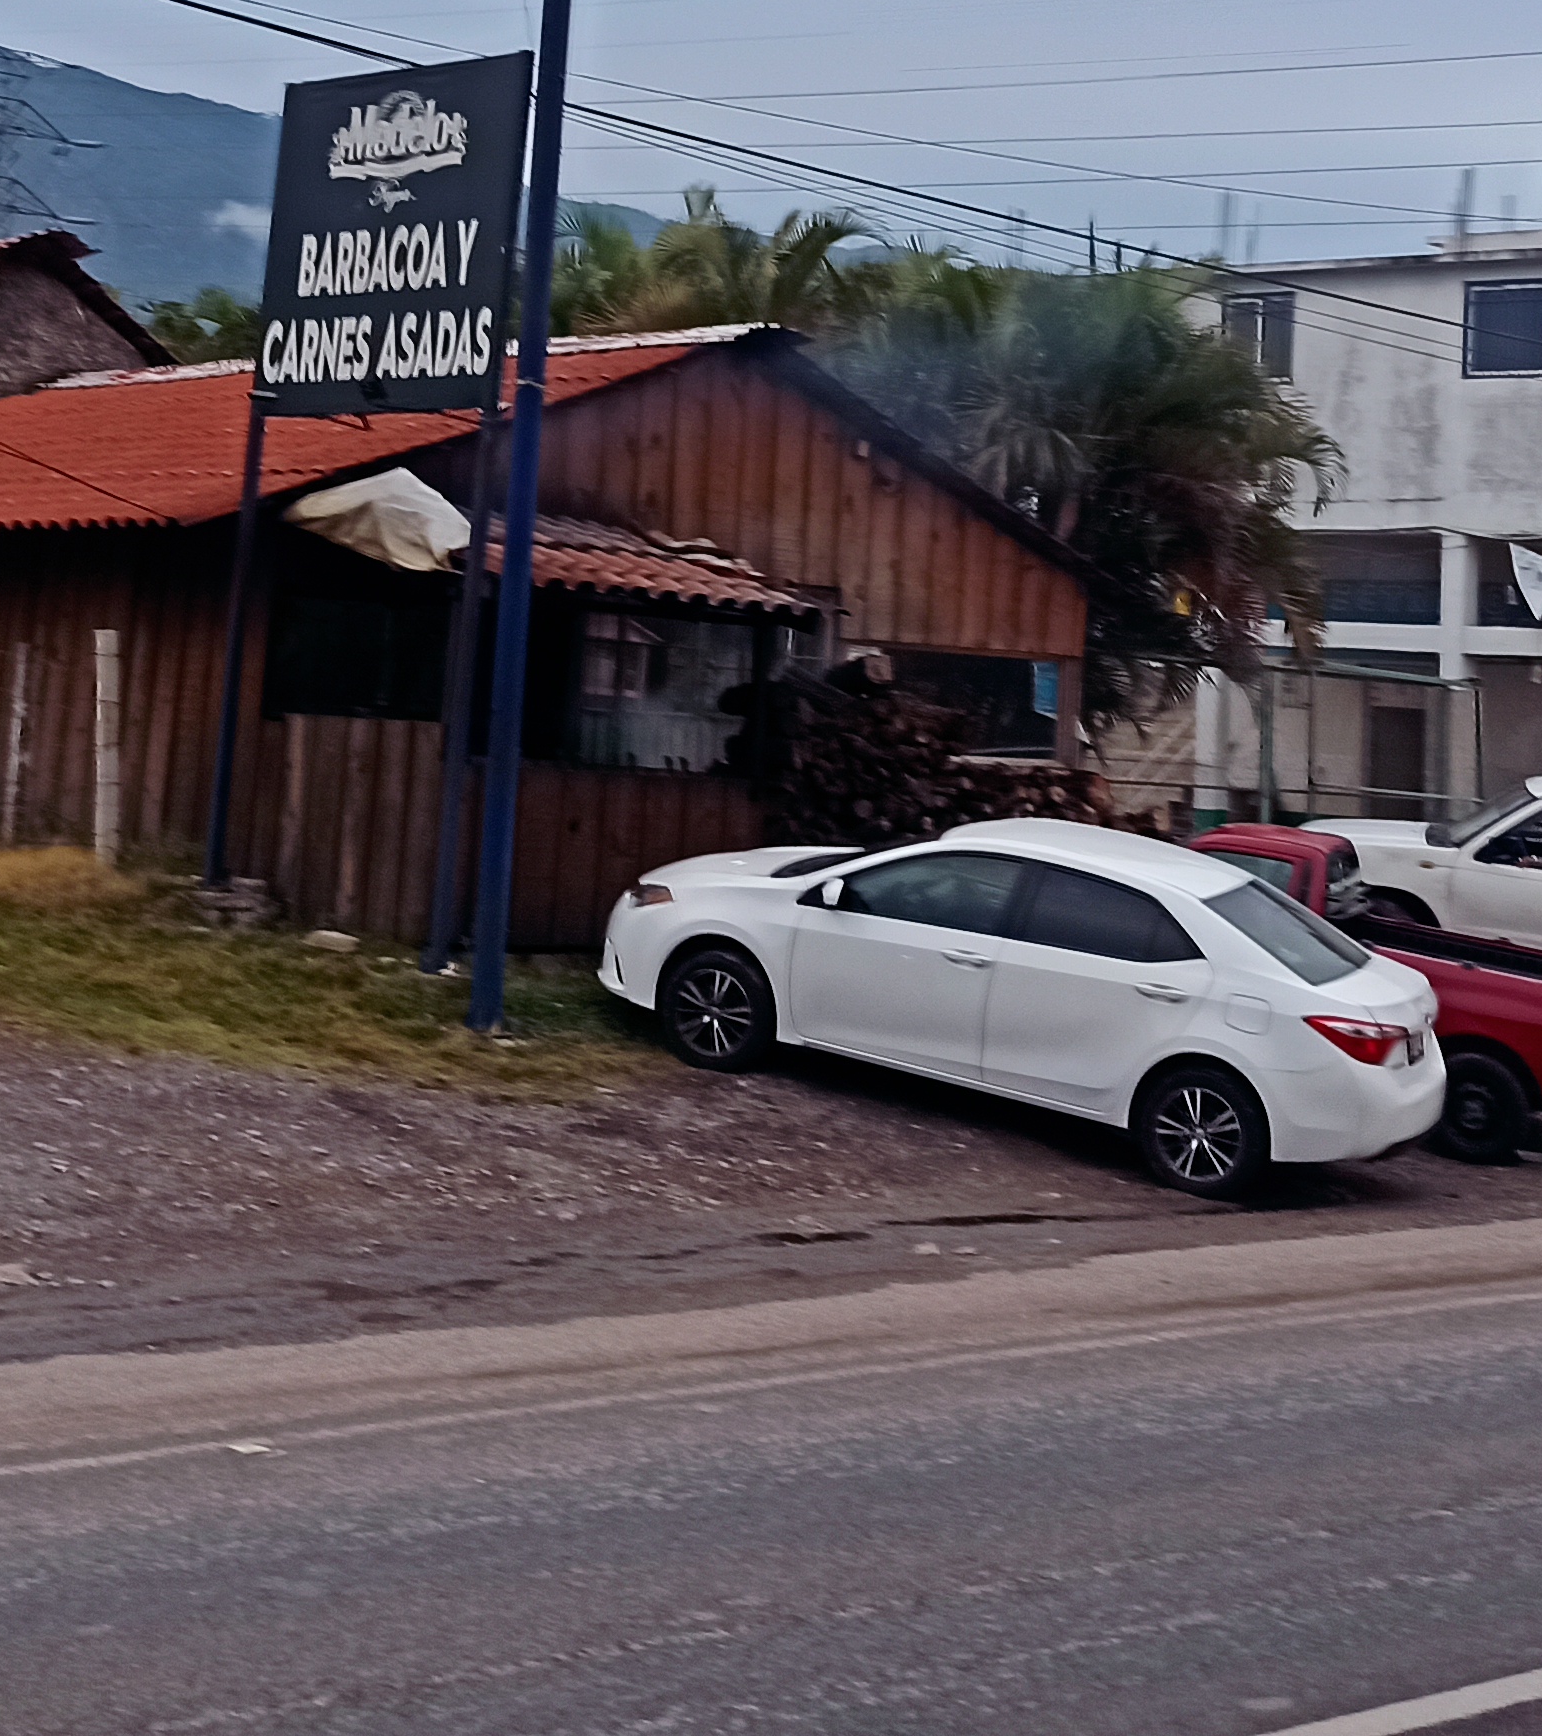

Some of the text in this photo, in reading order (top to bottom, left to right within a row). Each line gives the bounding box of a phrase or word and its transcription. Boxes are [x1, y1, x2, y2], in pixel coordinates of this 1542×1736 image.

[298, 218, 479, 297] BARBACOA Y
[262, 306, 492, 384] CARNES ASADAS
